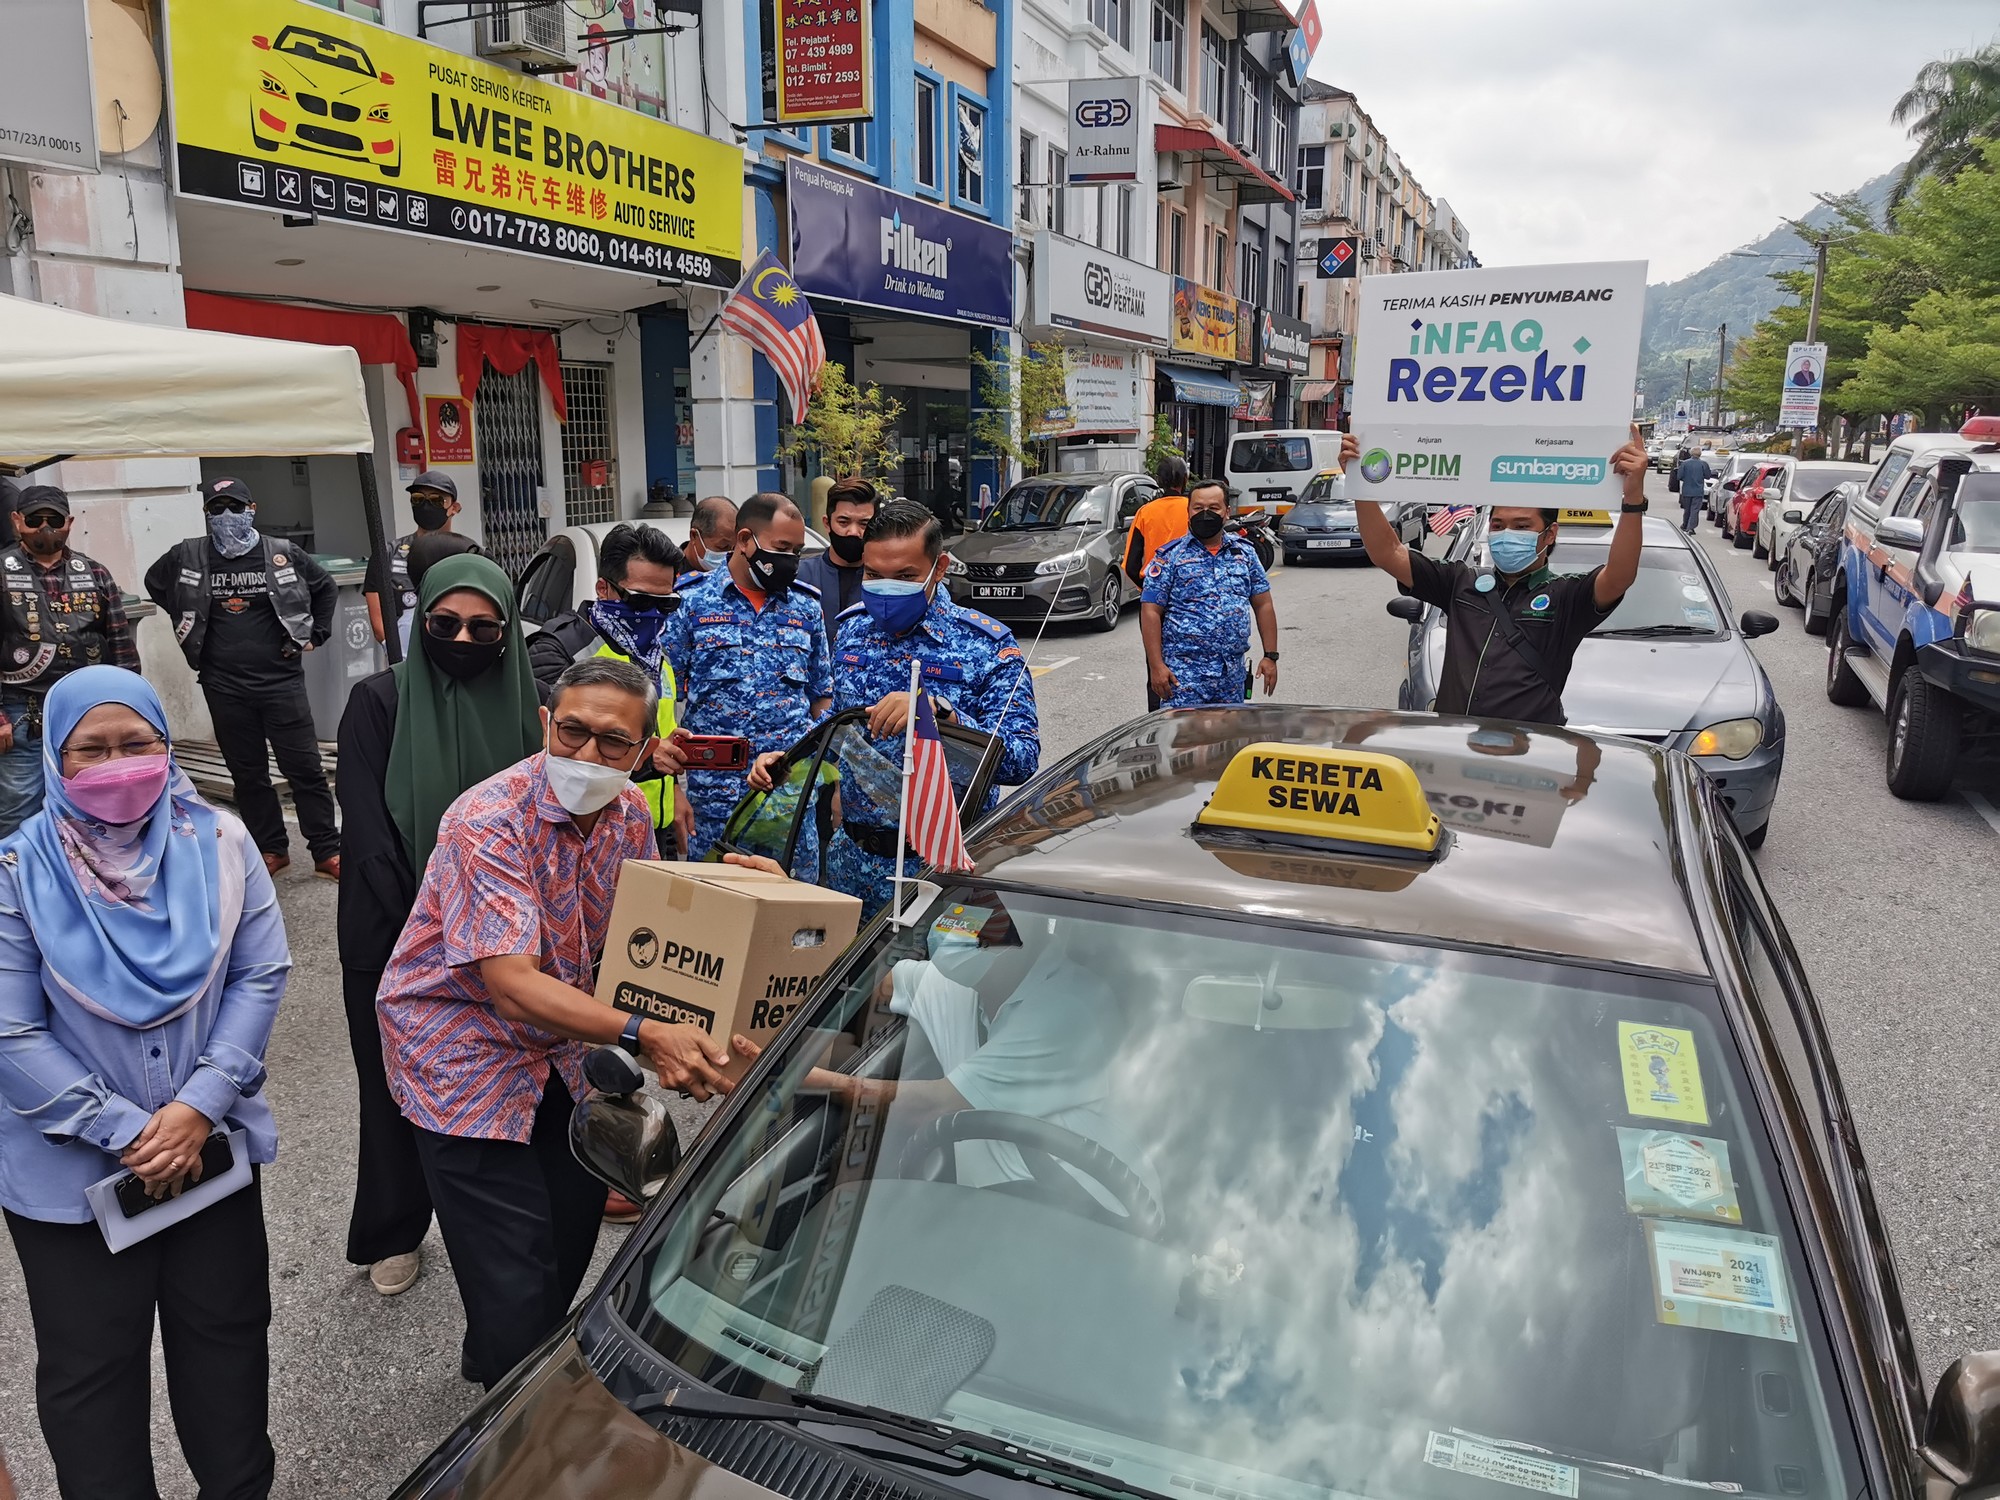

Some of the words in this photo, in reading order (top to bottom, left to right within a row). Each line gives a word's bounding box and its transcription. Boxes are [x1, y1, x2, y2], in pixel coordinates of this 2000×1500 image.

[785, 38, 799, 46] Tel.
[800, 35, 830, 46] Pejabat
[785, 49, 798, 60] 07
[807, 46, 826, 58] 439
[828, 43, 853, 56] 4989
[786, 65, 799, 74] Tel.
[801, 63, 827, 72] Bimbit
[786, 75, 805, 87] 012
[813, 73, 833, 85] 767
[835, 71, 860, 83] 2593
[429, 62, 468, 89] PUSAT
[470, 76, 510, 102] SERVIS
[512, 89, 552, 115] KERETA
[49, 137, 82, 154] 00015
[431, 92, 534, 163] LWEE
[543, 125, 696, 204] BROTHERS
[1076, 144, 1130, 157] Ar-Rahnu
[433, 149, 608, 221] 雷兄弟汽车维修
[795, 166, 820, 187] Penjual
[820, 175, 844, 196] Penapis
[845, 185, 855, 197] Air
[614, 201, 645, 228] AUTO
[649, 209, 695, 239] SERVICE
[468, 209, 551, 248] 017-773
[609, 238, 673, 271] 014-614
[676, 253, 712, 278] 4559
[880, 206, 948, 279] Filken
[884, 274, 907, 293] Drink
[908, 282, 916, 295] to
[916, 281, 945, 301] Wellness
[1114, 293, 1145, 318] PERTAMA
[1383, 298, 1436, 311] TERIMA
[1440, 295, 1486, 308] KASIH
[1489, 288, 1613, 306] PENYUMBANG
[1091, 352, 1124, 371] AR-RAHNU
[1387, 336, 1592, 403] Rezeki
[1417, 436, 1442, 445] Anjuran
[1534, 437, 1574, 447] Kerjasama
[1396, 453, 1462, 477] PPIM
[1496, 458, 1600, 480] sumbangan
[1567, 510, 1593, 518] SEWA
[992, 587, 1010, 596] 7617
[1011, 587, 1017, 596] F
[699, 616, 731, 624] GHAZALI
[788, 618, 802, 627] APM
[925, 666, 942, 676] APM
[1252, 756, 1383, 792] KERETA
[1268, 785, 1361, 817] SEWA
[940, 918, 970, 929] HELIX
[663, 940, 725, 982] PPIM
[1681, 1267, 1722, 1279] WNJ4679
[1730, 1259, 1759, 1273] 2021
[1732, 1274, 1742, 1282] 21
[1744, 1275, 1762, 1285] SEP
